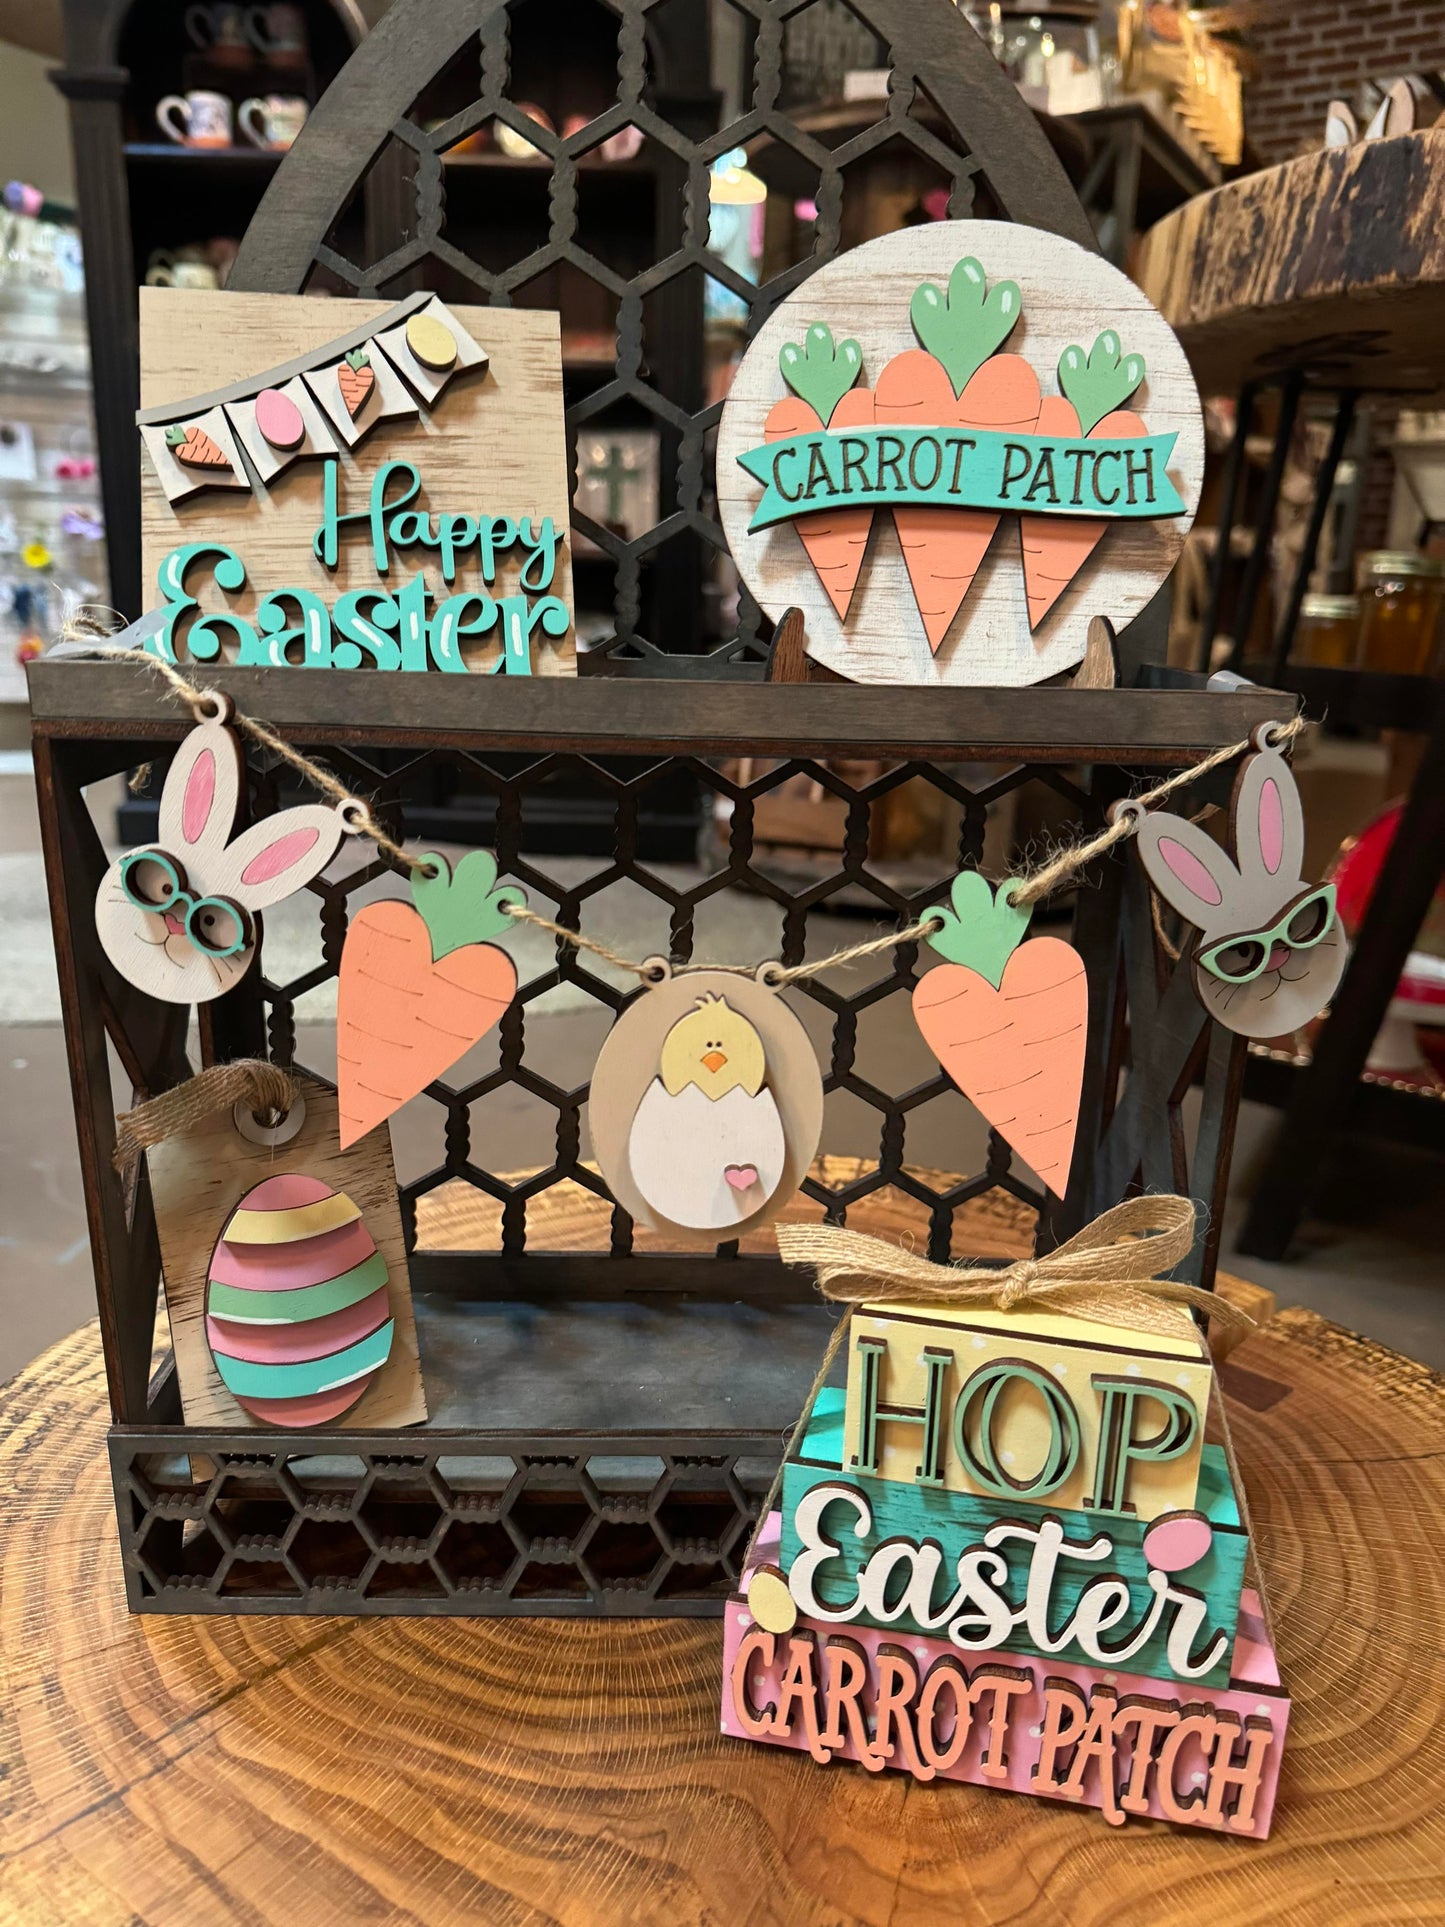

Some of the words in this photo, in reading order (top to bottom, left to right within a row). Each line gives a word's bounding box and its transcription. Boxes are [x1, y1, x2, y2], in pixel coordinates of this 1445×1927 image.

[313, 460, 564, 590] Happy
[771, 436, 979, 503] CARROT
[1000, 443, 1157, 505] PATCH
[144, 542, 569, 676] Easter
[849, 1335, 1199, 1516] HOP
[789, 1481, 1229, 1678] Easter
[730, 1627, 1034, 1782] CARROT
[1031, 1675, 1273, 1831] PATCH
